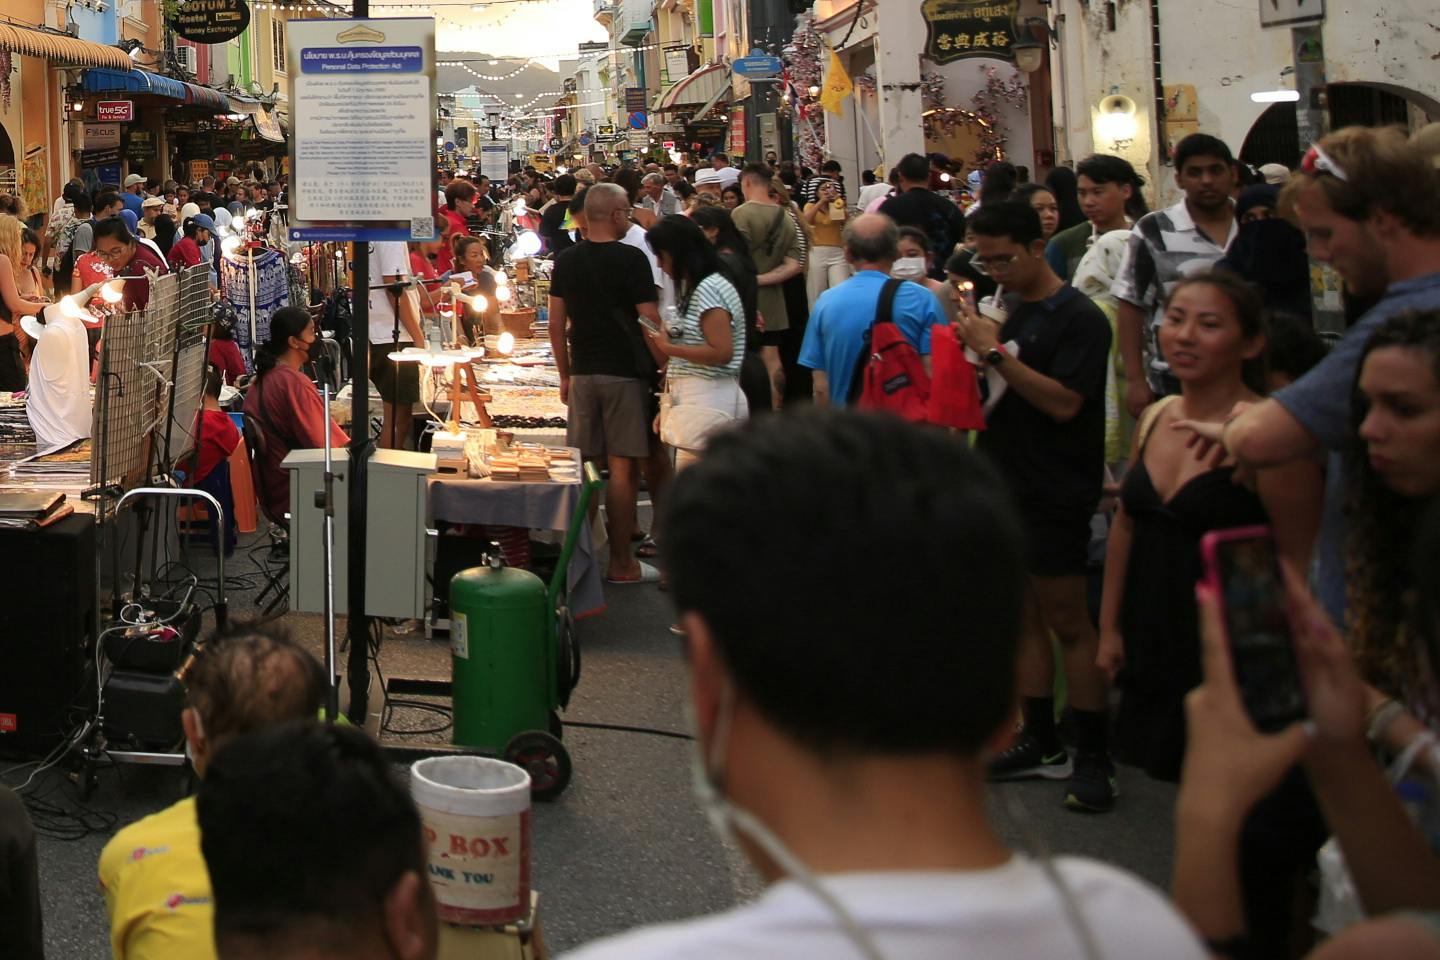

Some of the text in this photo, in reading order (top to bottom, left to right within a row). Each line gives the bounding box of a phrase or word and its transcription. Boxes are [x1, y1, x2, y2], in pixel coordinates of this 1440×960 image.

[322, 63, 346, 71] Personal
[449, 834, 509, 858] BOX
[462, 871, 496, 884] YOU
